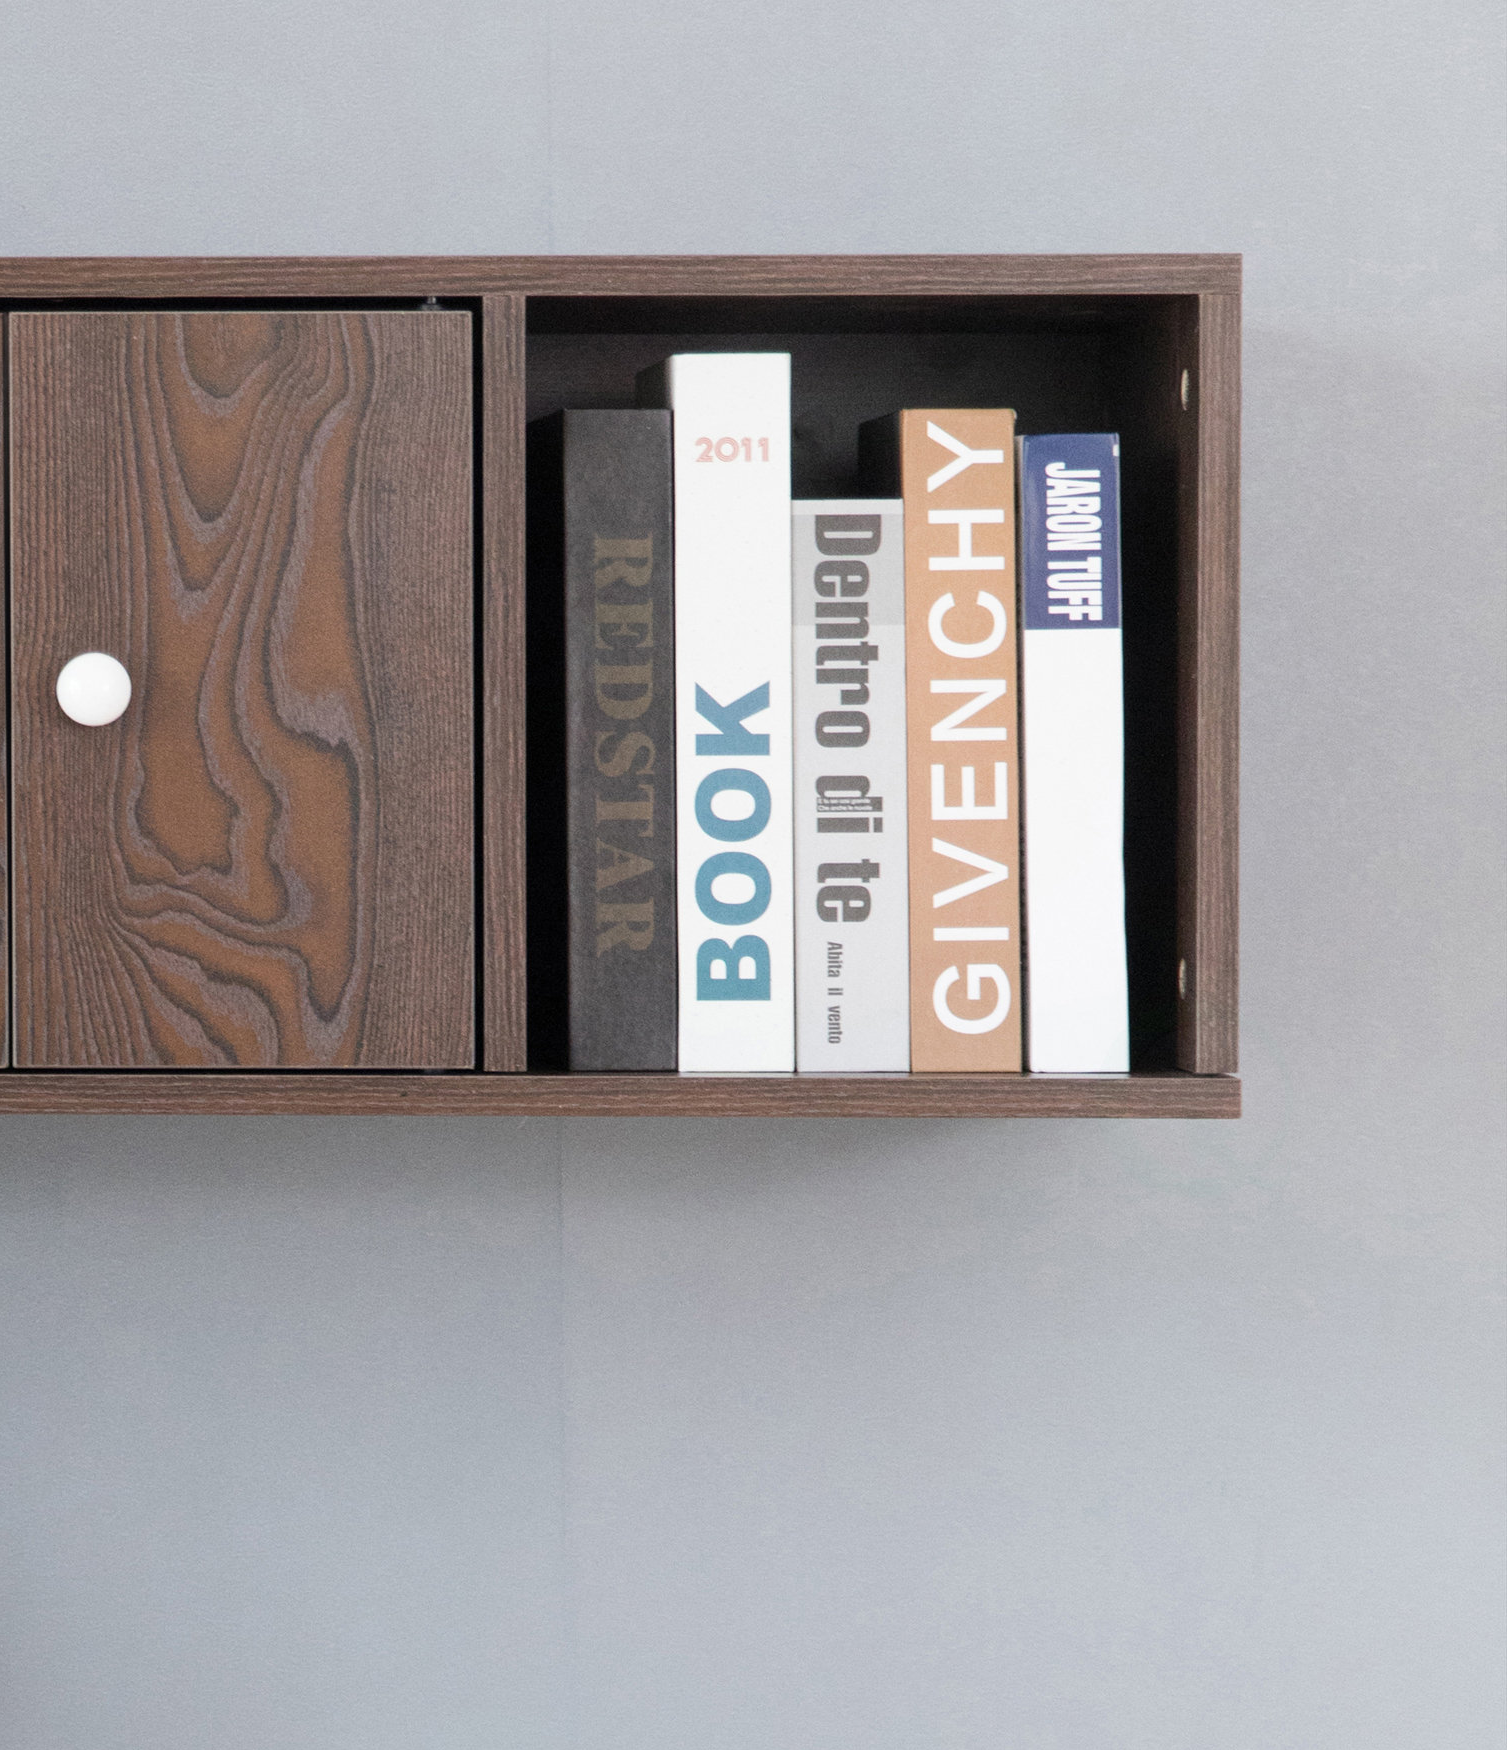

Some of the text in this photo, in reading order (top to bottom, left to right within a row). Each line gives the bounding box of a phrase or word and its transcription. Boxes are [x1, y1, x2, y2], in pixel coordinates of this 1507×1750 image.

[695, 436, 771, 463] 2011
[1044, 461, 1103, 622] JARON TUFF
[814, 514, 882, 748] Dentro
[592, 536, 657, 957] REDSTAR
[926, 420, 1012, 1035] GIVENCHY
[695, 680, 772, 1001] BOOK
[815, 775, 883, 833] di
[816, 858, 880, 923] te
[827, 941, 843, 978] Abita
[827, 1005, 842, 1044] vento
